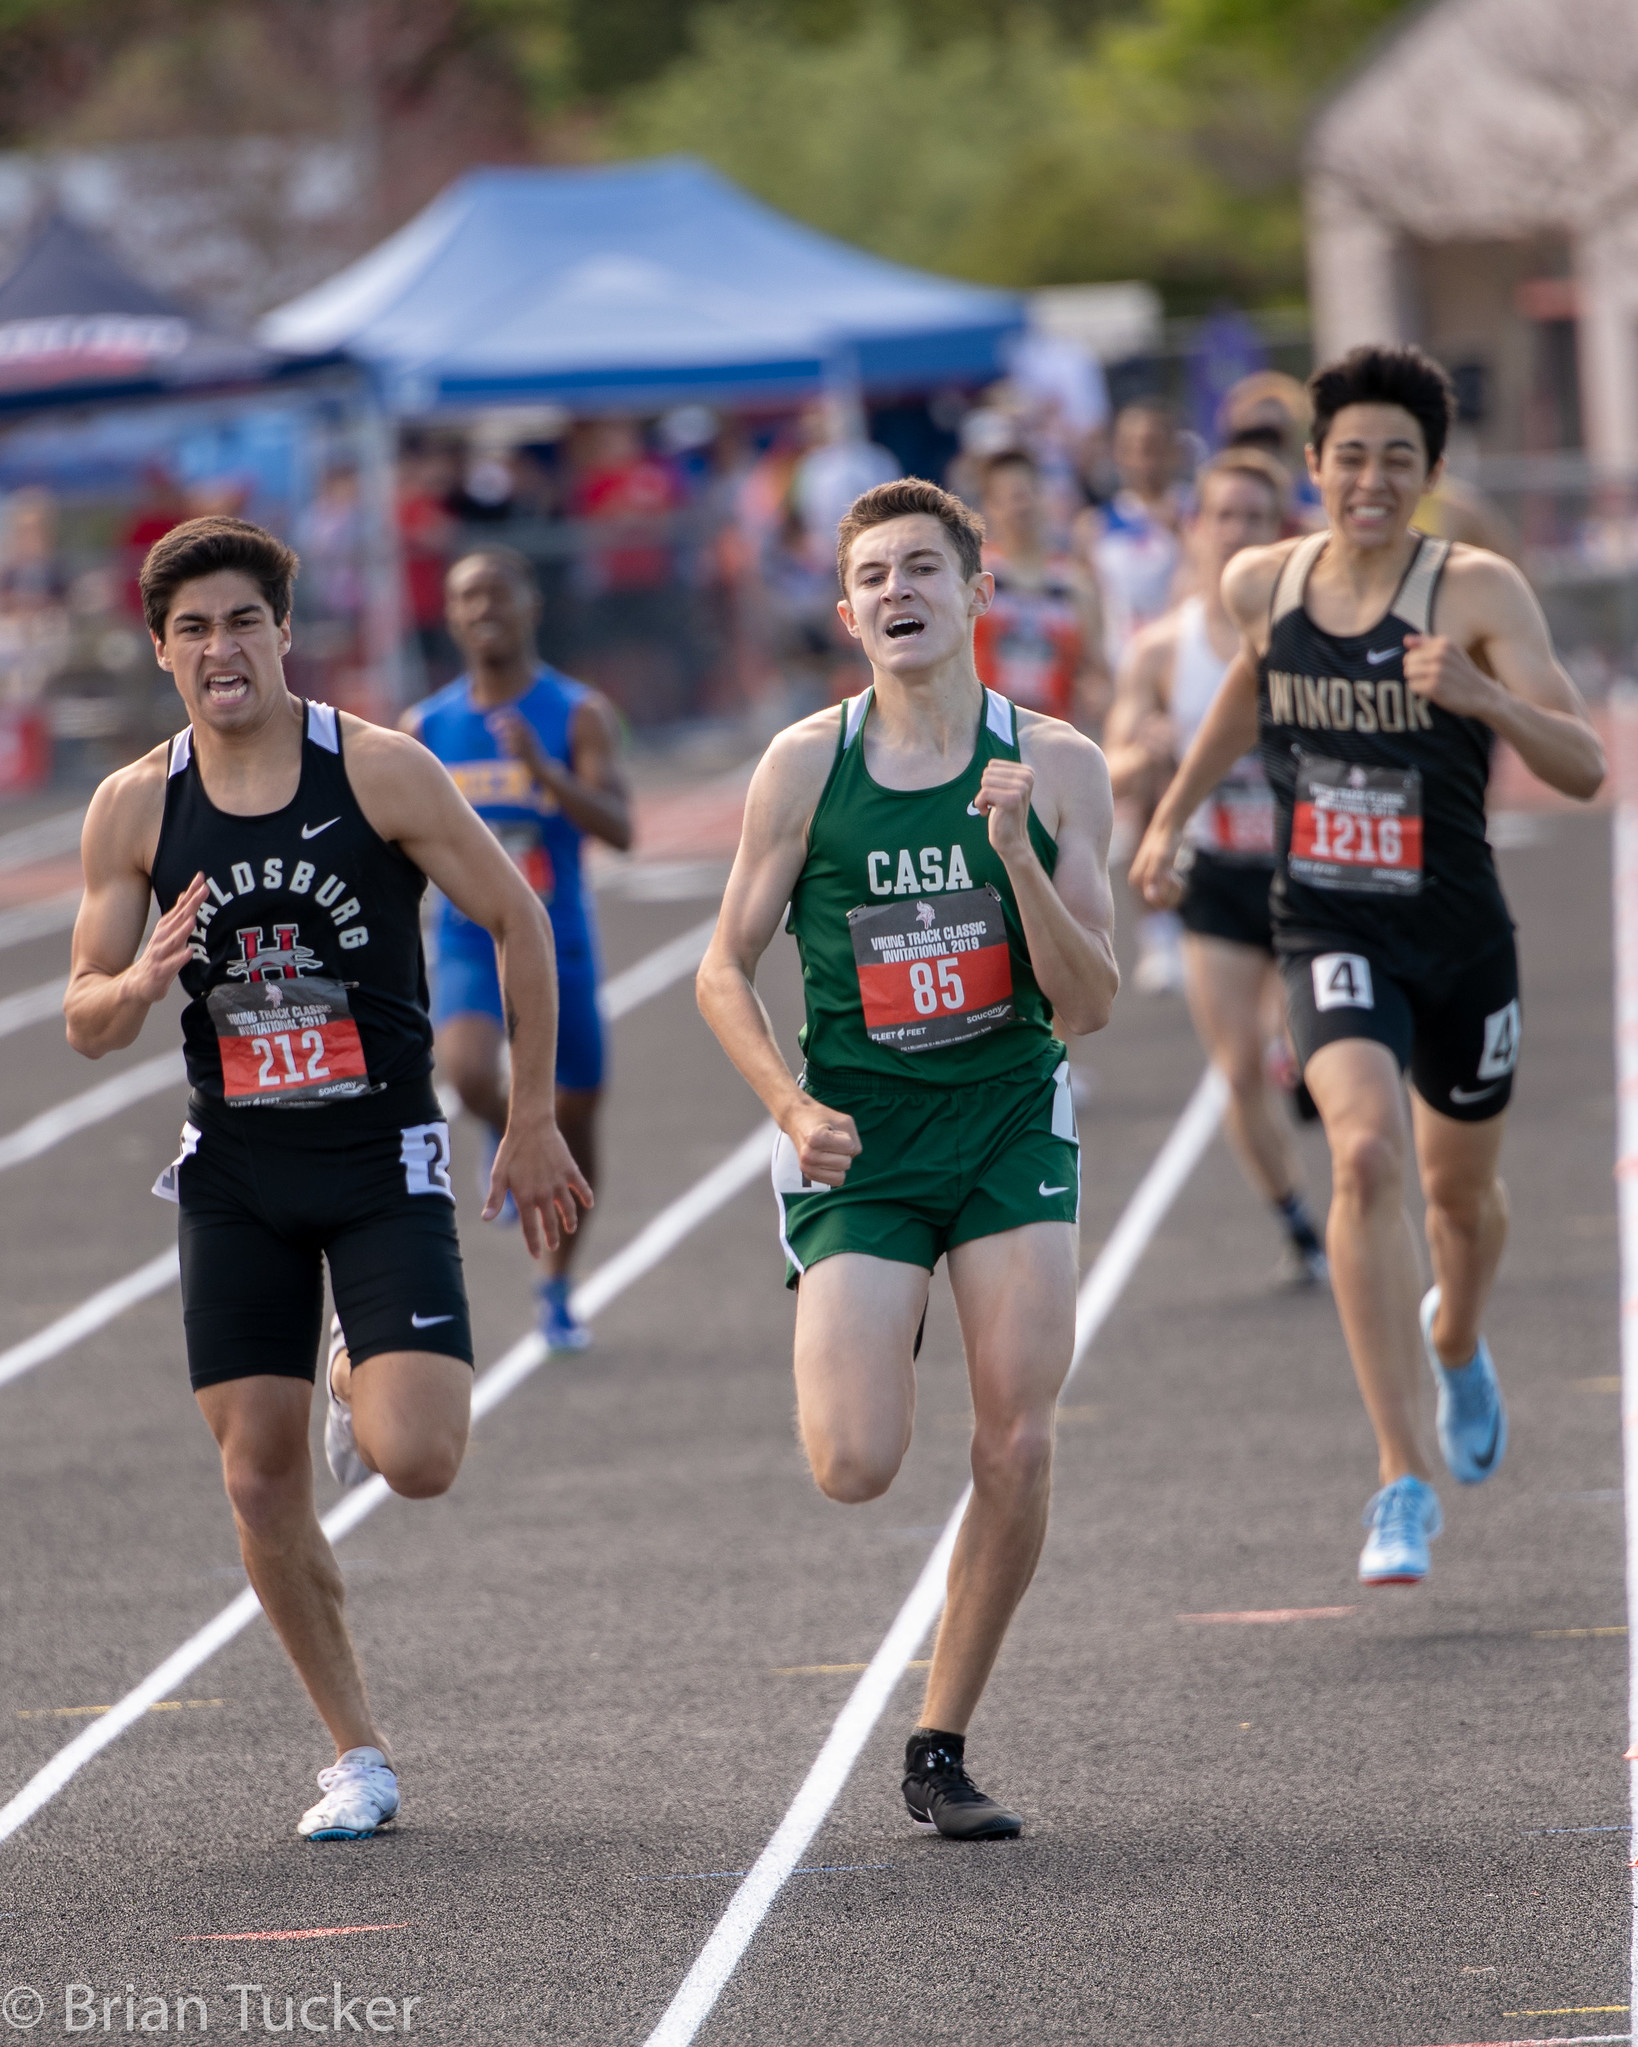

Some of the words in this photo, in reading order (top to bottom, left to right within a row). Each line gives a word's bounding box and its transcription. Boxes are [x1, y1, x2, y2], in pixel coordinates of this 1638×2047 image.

[1268, 669, 1433, 733] WINDSOR
[1310, 808, 1402, 864] 1216
[867, 844, 973, 896] CASA
[871, 935, 905, 951] VIKING
[906, 929, 942, 946] TRACK
[943, 920, 987, 941] CLASSIC
[882, 944, 949, 964] INVITATIONAL
[951, 936, 980, 953] 2019
[909, 957, 965, 1015] 85
[1329, 961, 1361, 999] 4
[226, 1010, 258, 1025] VIKING
[258, 1006, 290, 1021] TRACK
[238, 1018, 300, 1037] INVITATIONAL
[966, 1005, 1003, 1024] saucony
[871, 1030, 896, 1042] FLEET
[906, 1026, 927, 1036] FEET
[251, 1029, 331, 1087] 212
[318, 1081, 357, 1097] saucony
